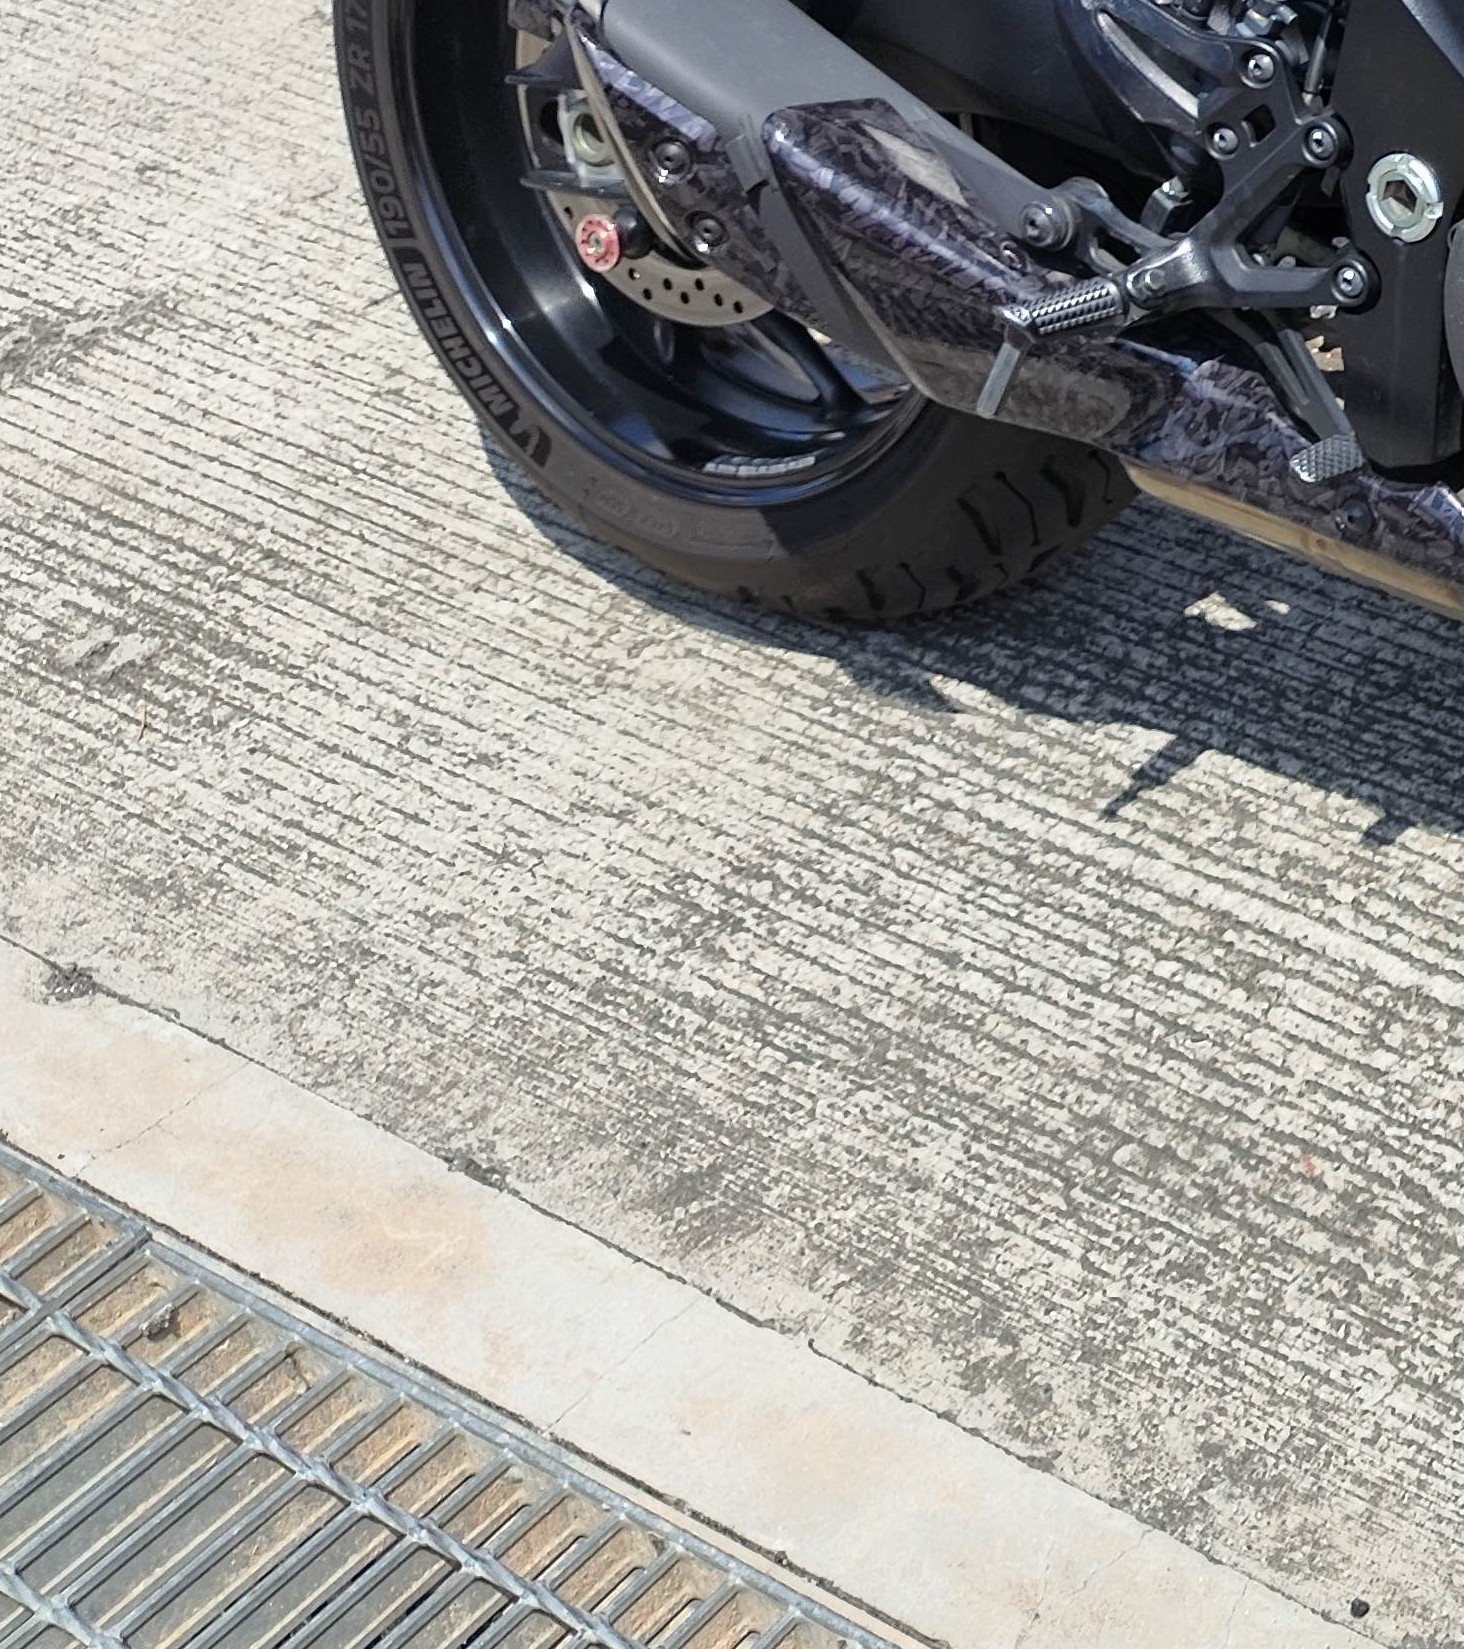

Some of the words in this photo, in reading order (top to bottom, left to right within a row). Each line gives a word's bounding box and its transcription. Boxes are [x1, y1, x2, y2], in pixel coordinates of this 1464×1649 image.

[349, 49, 376, 96] ZR
[356, 106, 413, 239] 190/55
[404, 262, 517, 417] MICHELIN
